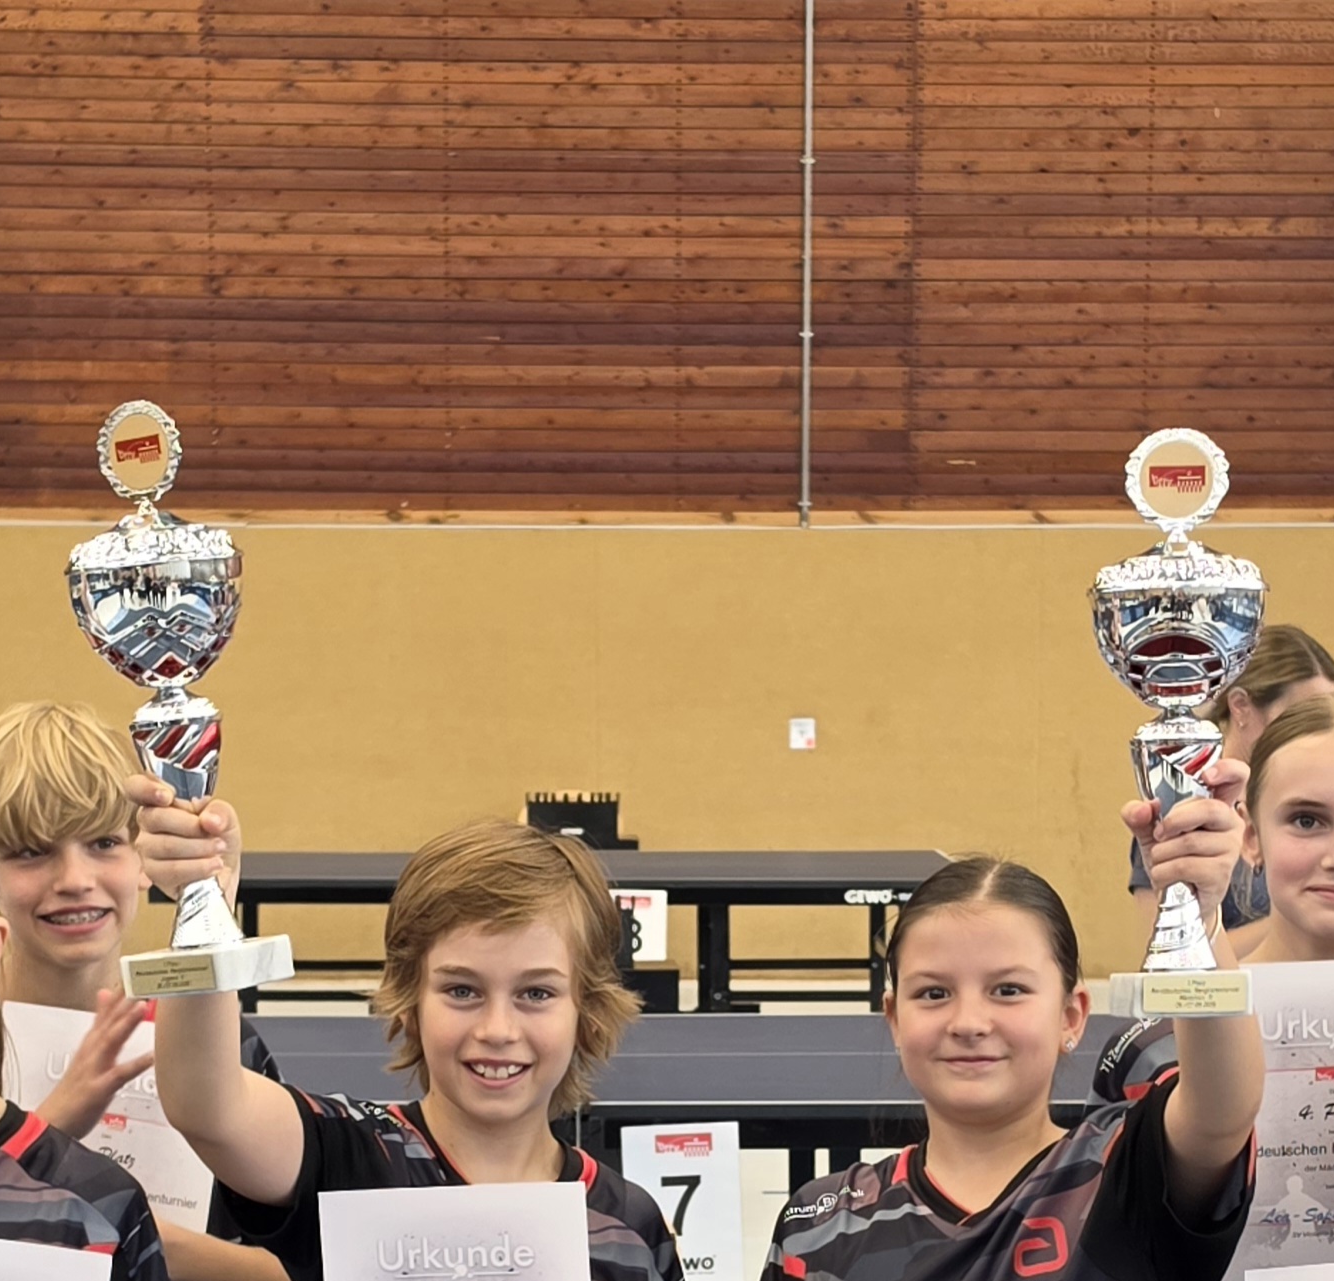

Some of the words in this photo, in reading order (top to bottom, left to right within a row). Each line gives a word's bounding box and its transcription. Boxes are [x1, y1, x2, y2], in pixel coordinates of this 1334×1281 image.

[1257, 1143, 1326, 1158] deutschen
[661, 1174, 701, 1236] 7
[377, 1234, 536, 1272] Urkunde
